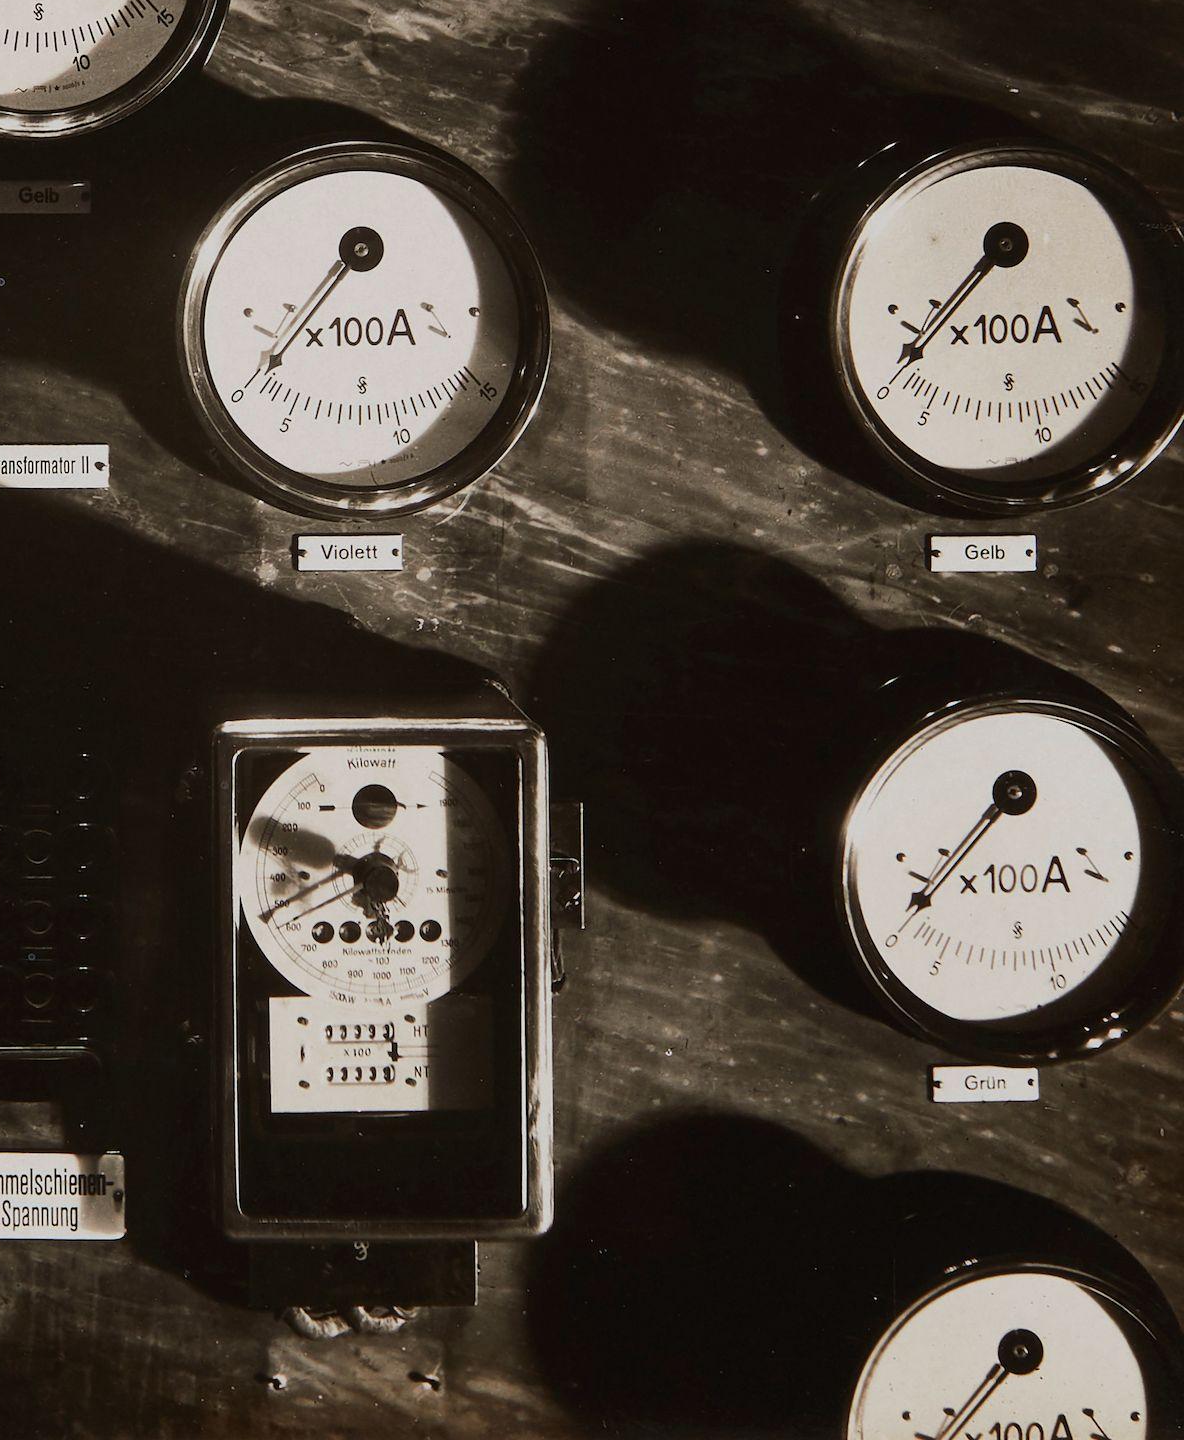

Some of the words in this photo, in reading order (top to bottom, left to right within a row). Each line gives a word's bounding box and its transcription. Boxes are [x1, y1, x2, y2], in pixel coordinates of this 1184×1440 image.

[72, 54, 90, 72] 10
[156, 8, 175, 27] 15
[18, 186, 60, 203] Gelb
[231, 389, 244, 403] 0
[279, 418, 292, 433] 5
[392, 428, 411, 445] 10
[479, 382, 498, 401] 15
[877, 386, 890, 400] 0
[917, 411, 930, 426] 5
[1035, 427, 1052, 444] 10
[81, 456, 89, 474] II
[321, 544, 377, 560] Violett
[965, 544, 1005, 560] Gelb
[346, 758, 396, 769] Kilowatt
[297, 801, 311, 810] 100
[270, 873, 286, 882] 400
[301, 943, 317, 952] 700
[421, 956, 440, 965] 1200
[885, 933, 898, 948] 0
[929, 961, 941, 976] 5
[1049, 973, 1066, 990] 10
[347, 969, 364, 978] 900
[372, 971, 392, 980] 1000
[399, 967, 416, 975] 1100
[413, 1025, 429, 1037] HT
[414, 1065, 429, 1078] NT
[964, 1074, 1006, 1090] Grün
[1, 1200, 78, 1231] Spannung
[966, 1414, 1075, 1440] 100A
